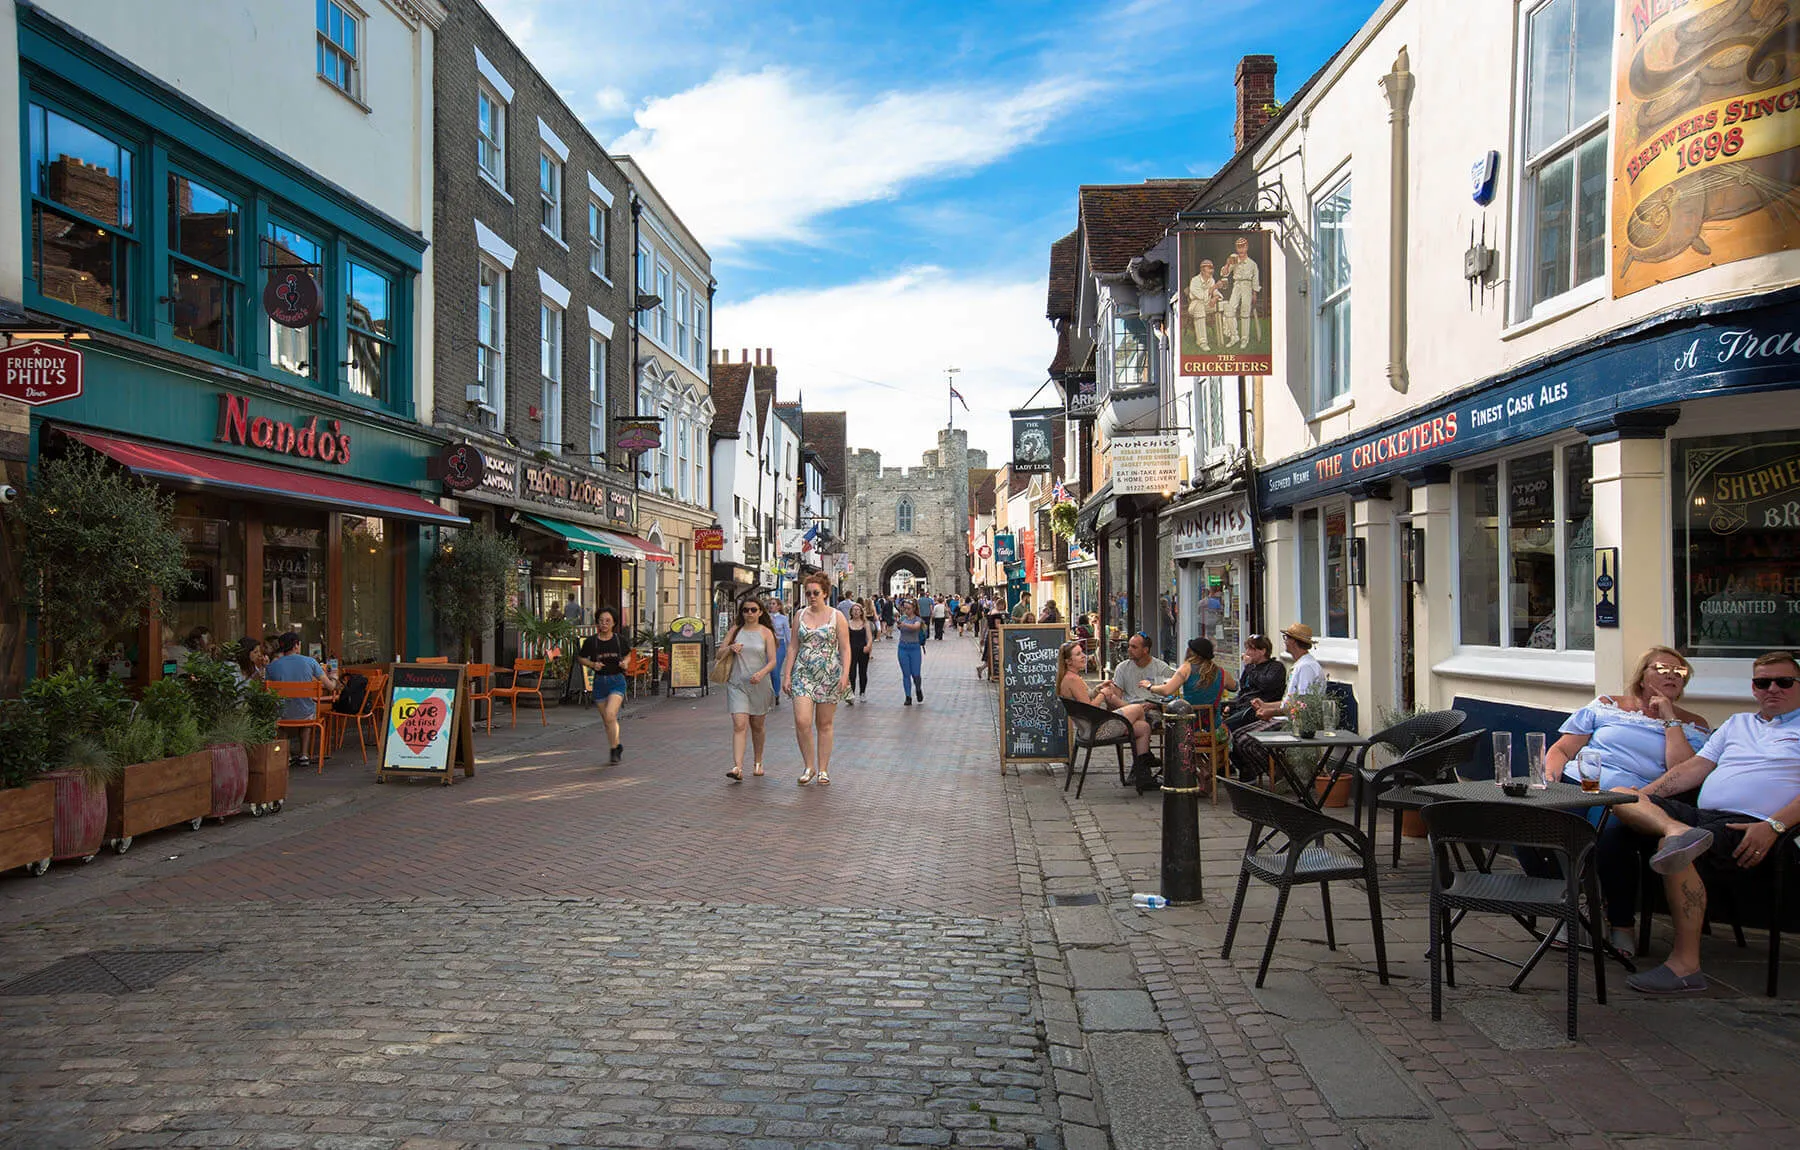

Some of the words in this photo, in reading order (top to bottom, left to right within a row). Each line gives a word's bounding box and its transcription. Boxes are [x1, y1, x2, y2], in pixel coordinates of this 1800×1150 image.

[1627, 109, 1718, 185] BREWERS
[1722, 89, 1800, 126] SINC
[1677, 126, 1744, 173] 1698
[7, 357, 67, 369] FRIENDLY
[1674, 338, 1700, 372] A
[1183, 361, 1269, 373] CRICKETERS
[6, 369, 67, 385] PHIL'S
[25, 387, 48, 397] Diner
[219, 391, 351, 464] Nando's
[1315, 453, 1343, 481] THE
[1351, 411, 1458, 471] CRICKETERS
[1471, 404, 1502, 429] FINEST
[1506, 392, 1535, 417] CASK
[1539, 382, 1569, 407] ALES
[527, 468, 566, 498] TACOS
[570, 479, 603, 506] LOCOS
[1716, 459, 1800, 501] SHEPHE
[1176, 503, 1246, 543] MUNCHIES
[1699, 600, 1777, 614] GUARANTEED
[1016, 637, 1038, 651] THE
[1018, 648, 1059, 665] CRICKETER
[1005, 676, 1018, 687] OF
[1023, 674, 1046, 686] LOCAL
[405, 719, 417, 727] at
[418, 718, 437, 727] first
[403, 726, 438, 742] bite
